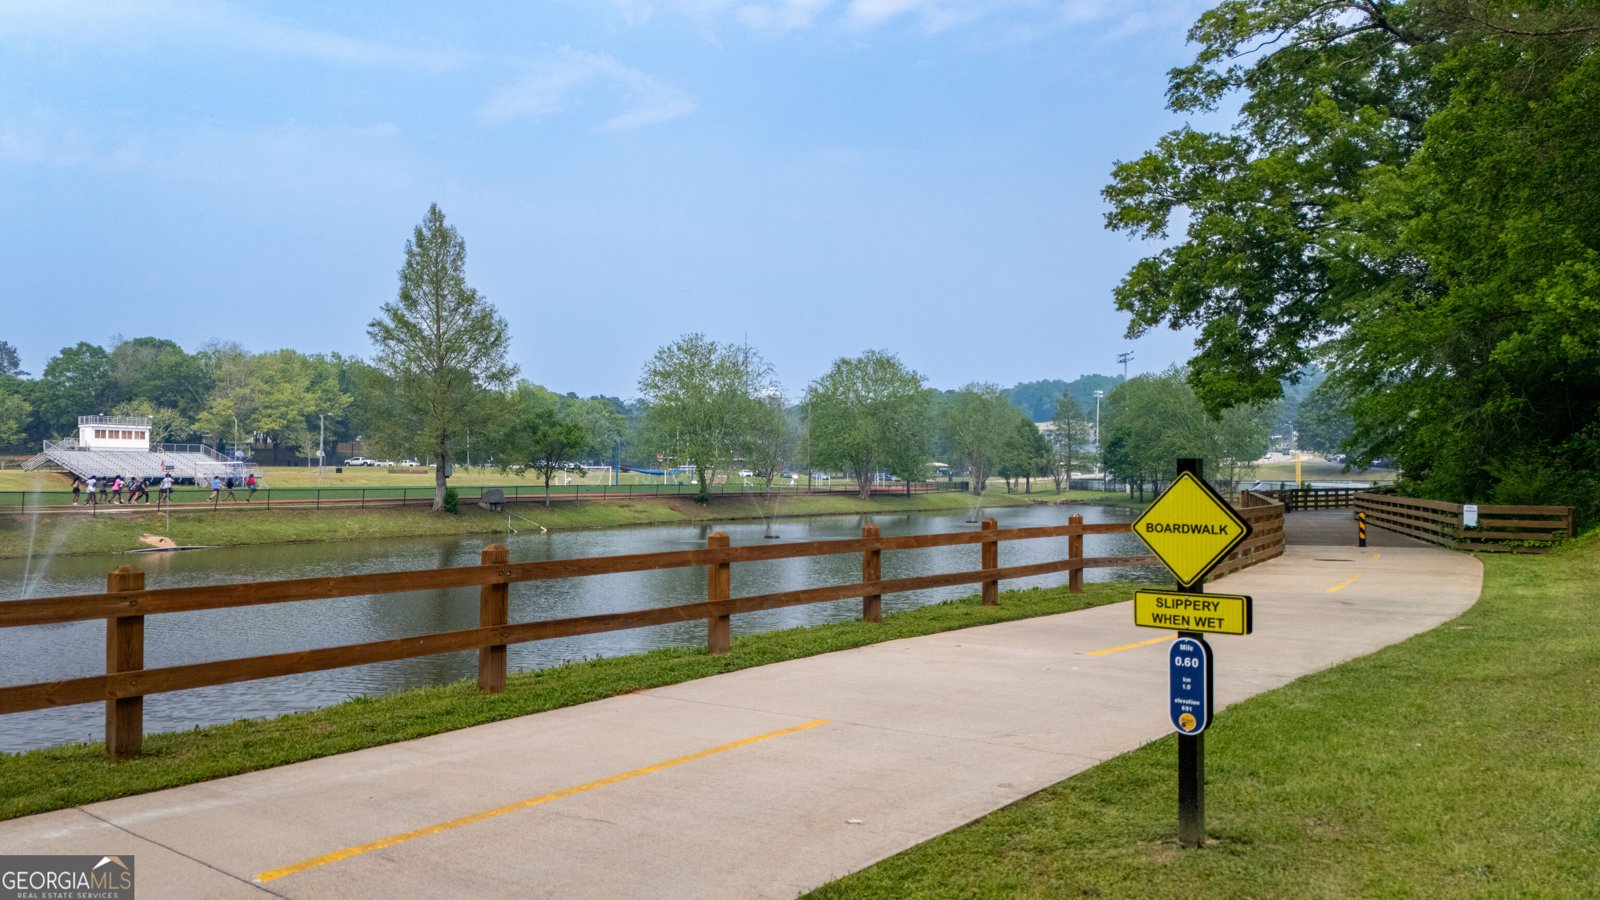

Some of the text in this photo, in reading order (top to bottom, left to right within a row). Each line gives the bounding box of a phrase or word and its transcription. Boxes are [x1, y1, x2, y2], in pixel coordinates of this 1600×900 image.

[1145, 522, 1229, 536] BOARDWALK
[1155, 597, 1220, 612] SLIPPERY
[1151, 612, 1225, 629] WHEN WET
[1179, 643, 1194, 652] Mile
[1174, 656, 1199, 668] 0.60
[1174, 698, 1201, 706] elevation
